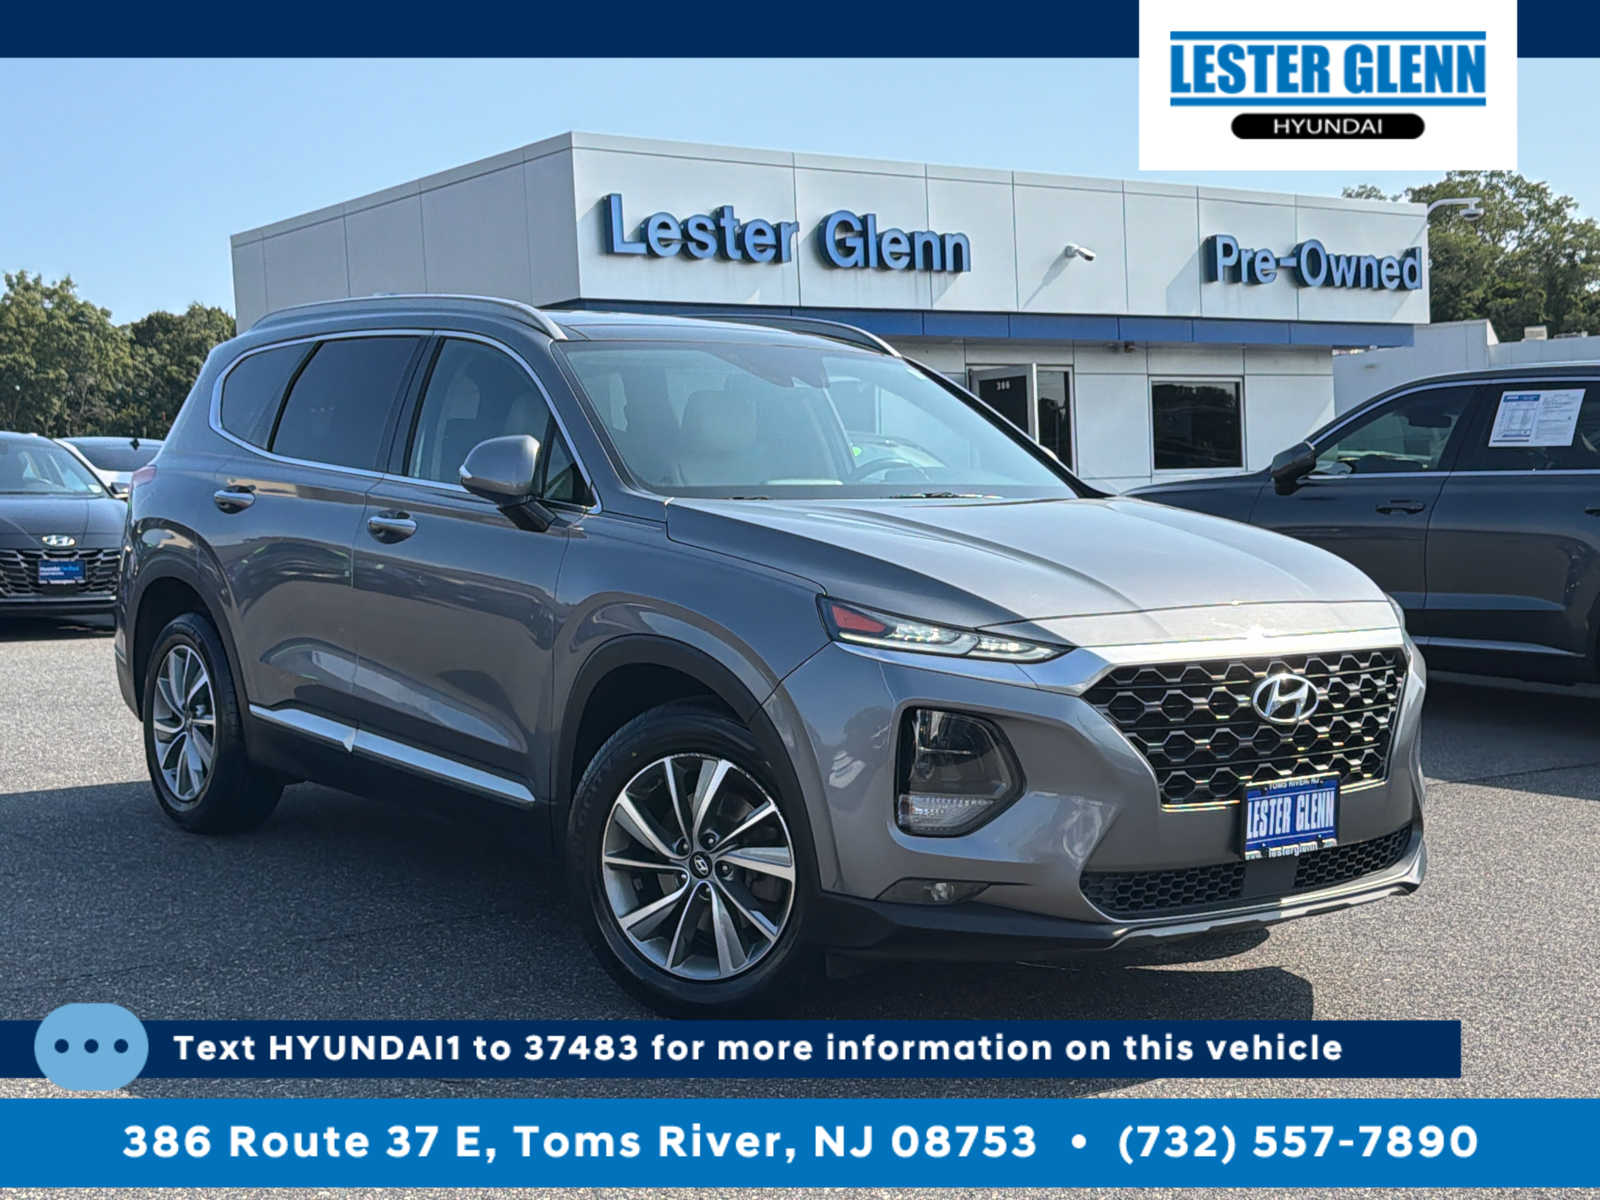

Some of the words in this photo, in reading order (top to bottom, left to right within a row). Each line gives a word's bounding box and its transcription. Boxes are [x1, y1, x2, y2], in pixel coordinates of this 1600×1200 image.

[605, 193, 799, 263] Lester
[816, 210, 971, 272] Glenn
[1206, 235, 1422, 291] Pre-Owned
[1246, 796, 1292, 839] LESTER
[1295, 791, 1335, 831] GLENN
